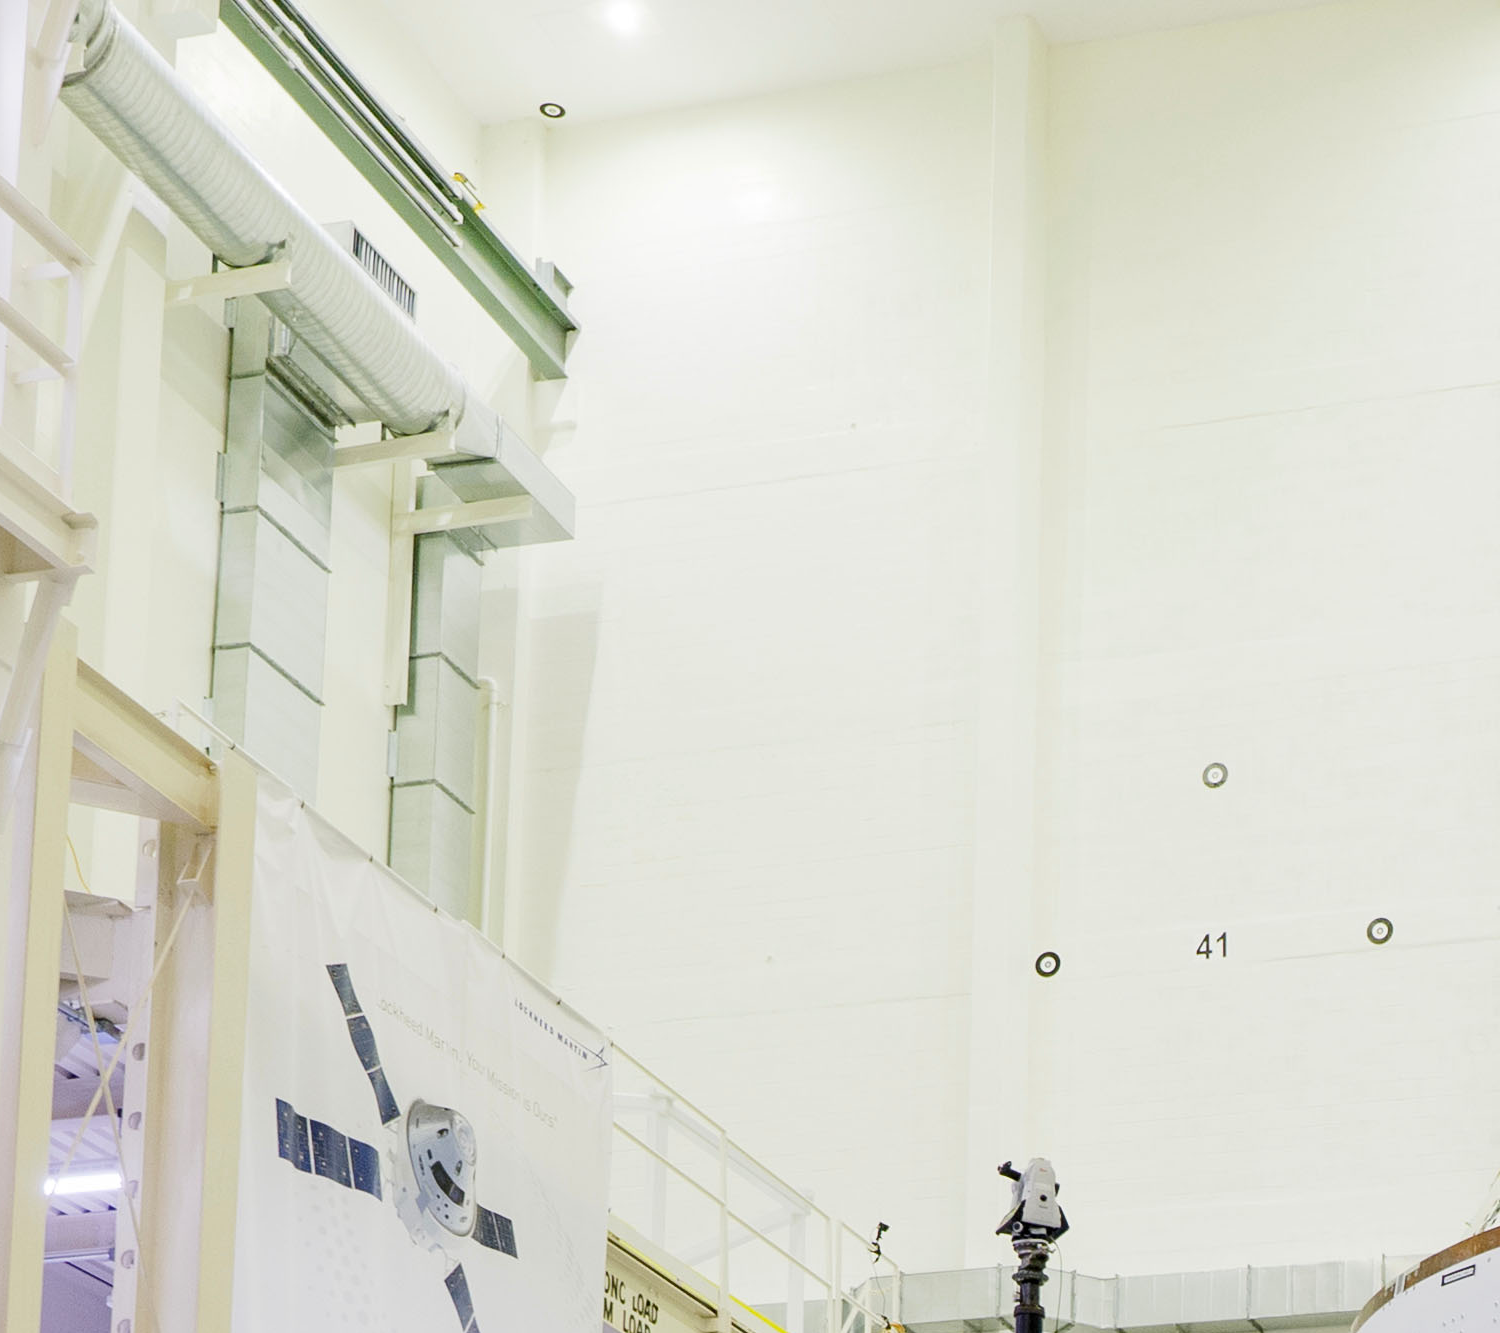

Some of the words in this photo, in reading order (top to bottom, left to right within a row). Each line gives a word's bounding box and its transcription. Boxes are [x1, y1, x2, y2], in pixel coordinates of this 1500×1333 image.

[1197, 932, 1229, 960] 41
[514, 998, 554, 1035] LOCKHEED
[557, 1031, 589, 1061] MARTIN
[632, 1293, 659, 1325] LOAD
